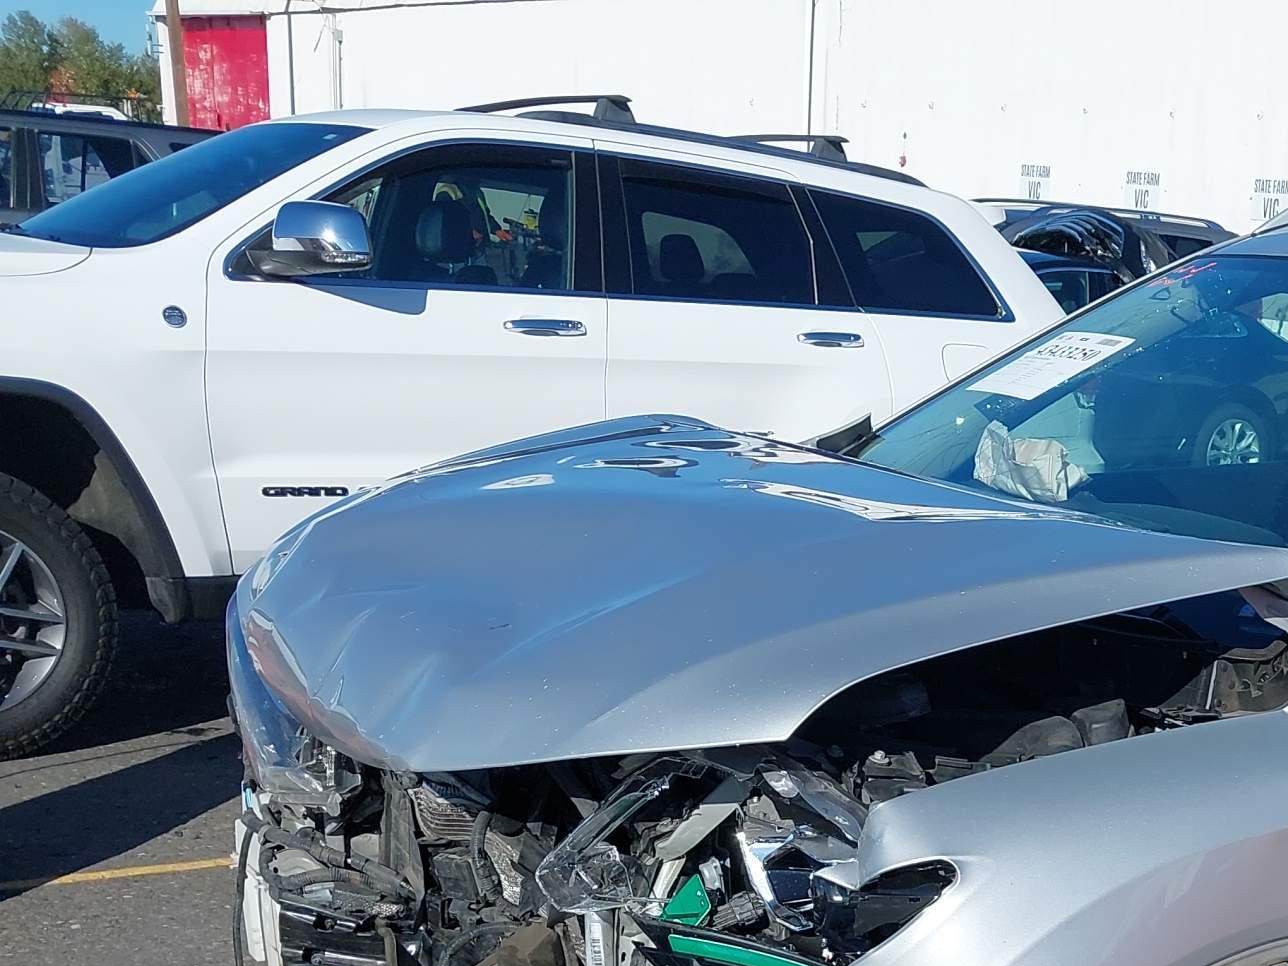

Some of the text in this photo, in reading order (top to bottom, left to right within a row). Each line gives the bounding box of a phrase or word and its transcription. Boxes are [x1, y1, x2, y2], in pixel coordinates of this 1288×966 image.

[1021, 164, 1051, 178] STATE FARM
[1126, 171, 1160, 187] STATE FARM
[1028, 180, 1041, 200] VIC
[1254, 179, 1271, 194] STATE
[1134, 188, 1149, 209] VIC
[1263, 197, 1279, 219] VIC
[261, 486, 349, 497] GRAND
